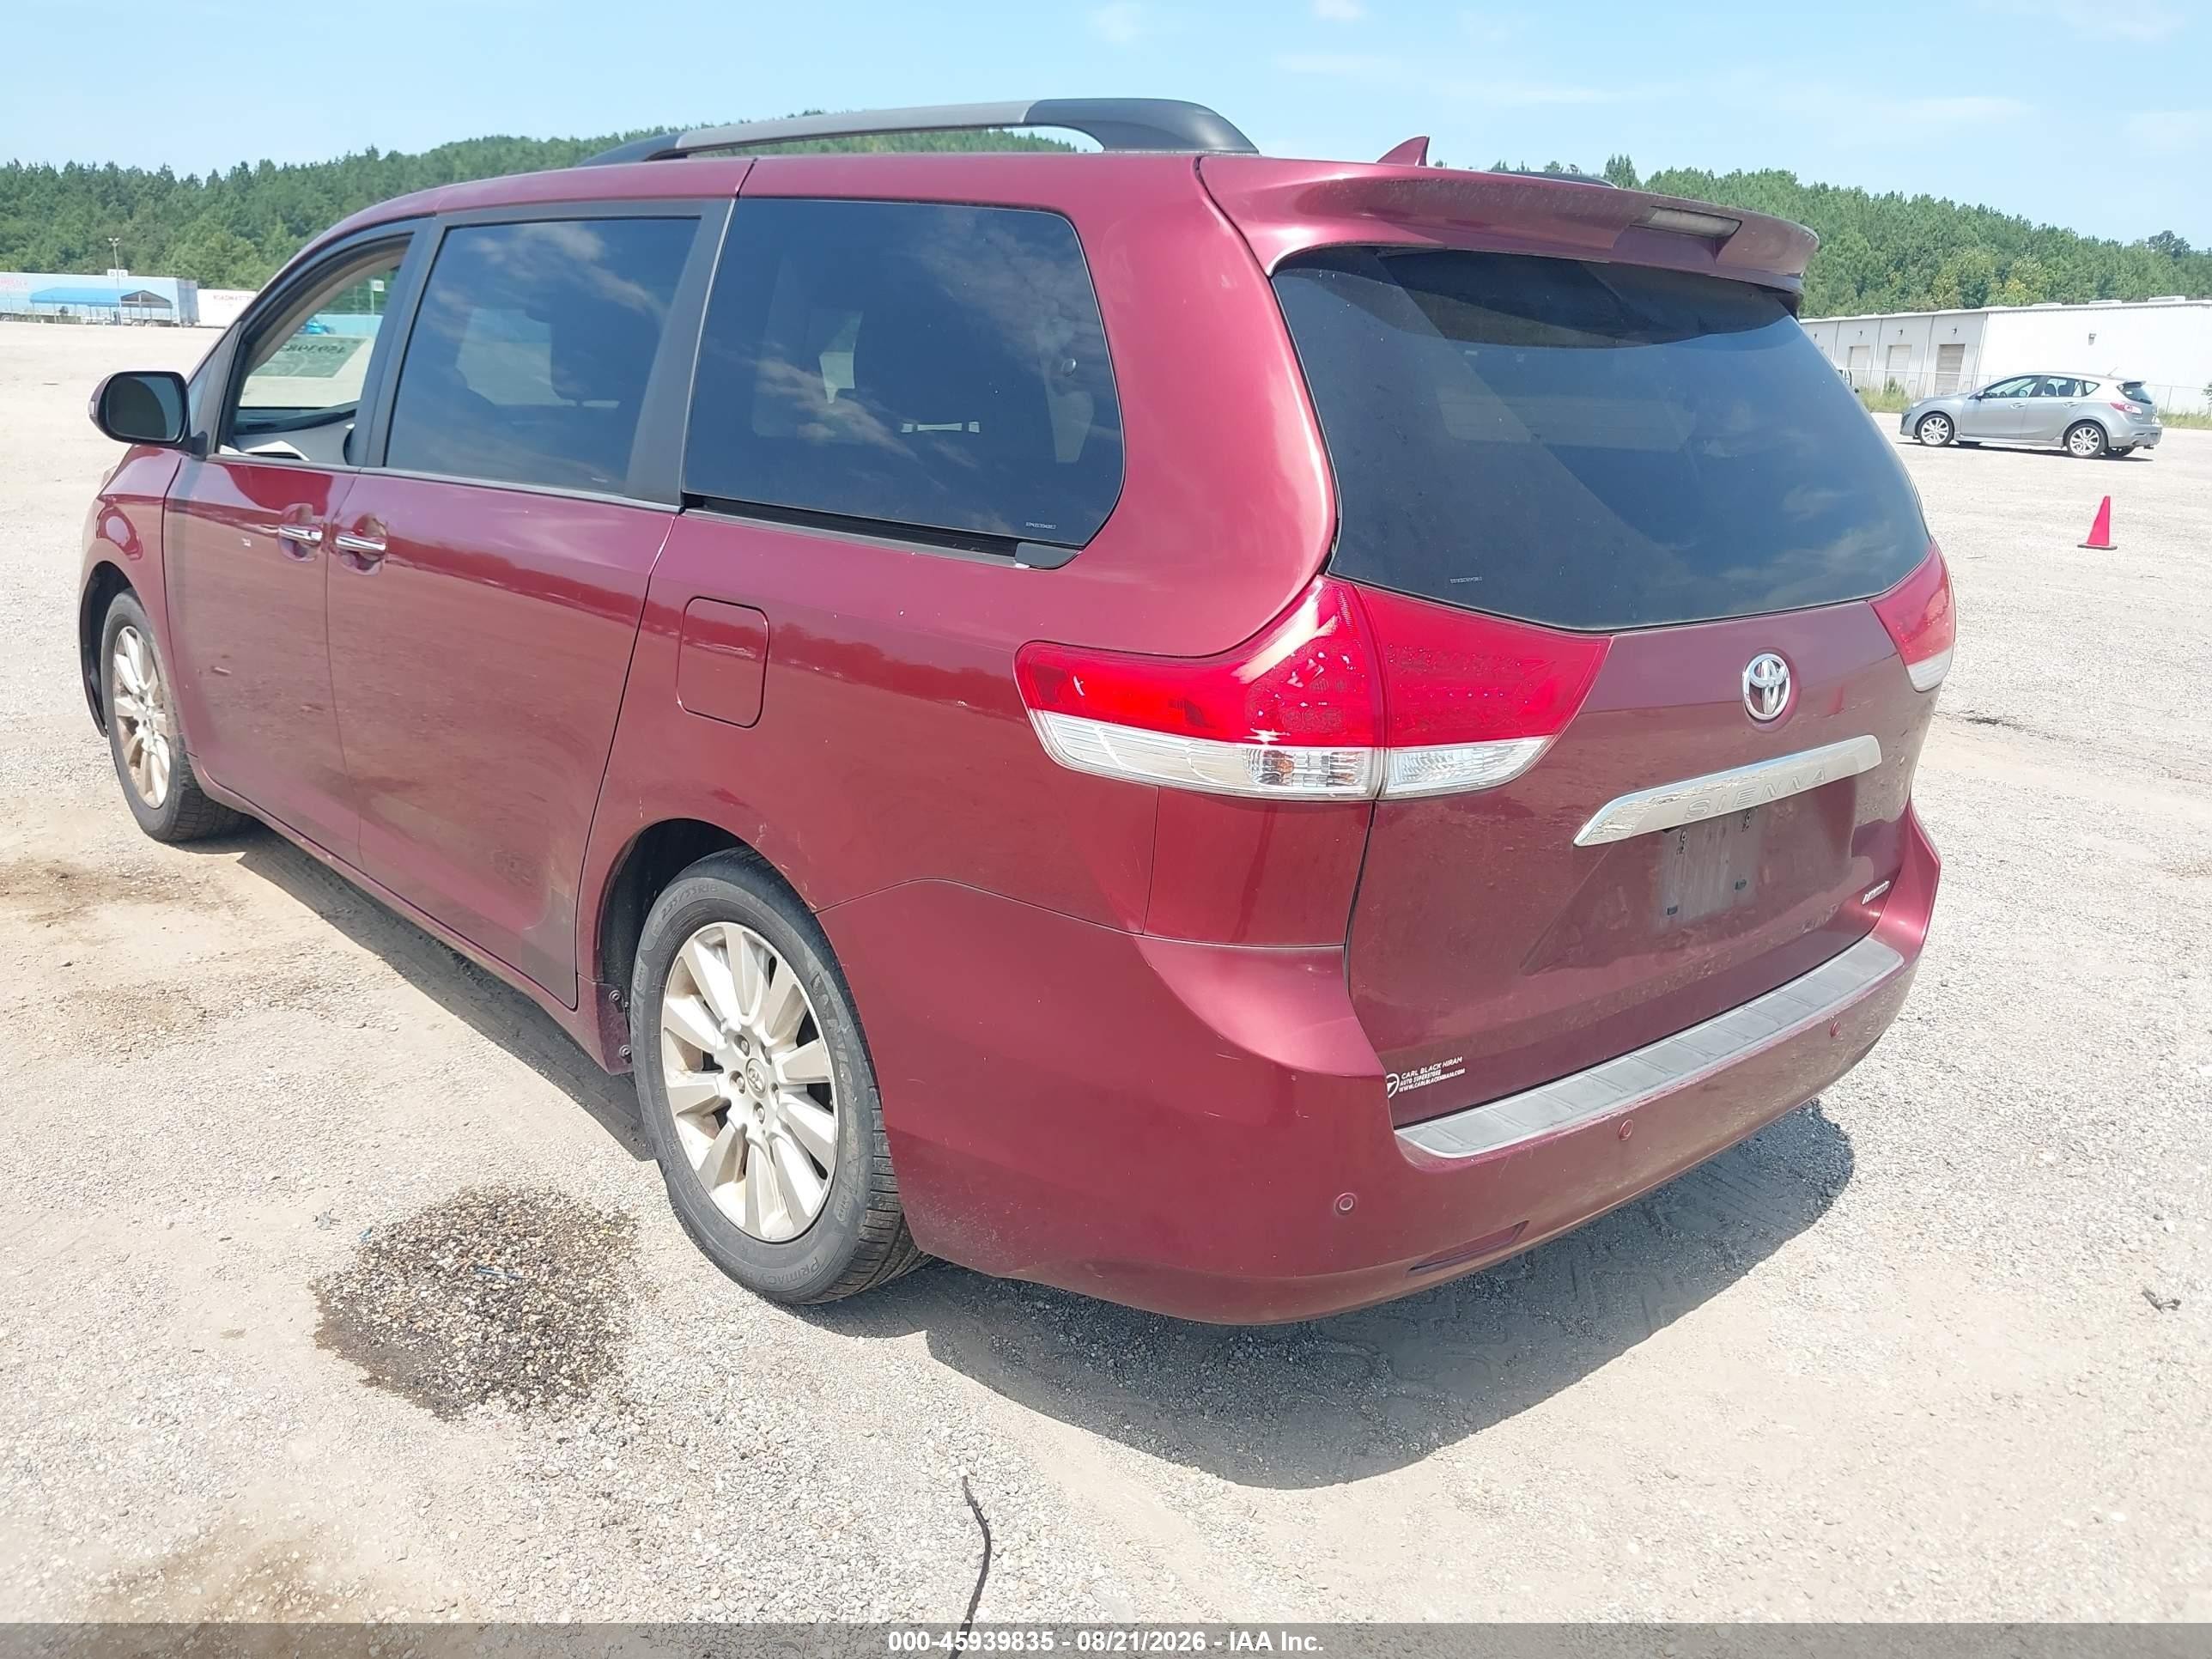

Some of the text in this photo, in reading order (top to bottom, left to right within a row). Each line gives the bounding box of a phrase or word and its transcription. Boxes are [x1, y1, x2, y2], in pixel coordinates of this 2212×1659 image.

[1686, 768, 1826, 819] SIENNA
[1401, 1056, 1463, 1079] CARL BLACK HIRAM
[1400, 1079, 1413, 1087] AUTO
[757, 1255, 821, 1285] PRIMACY
